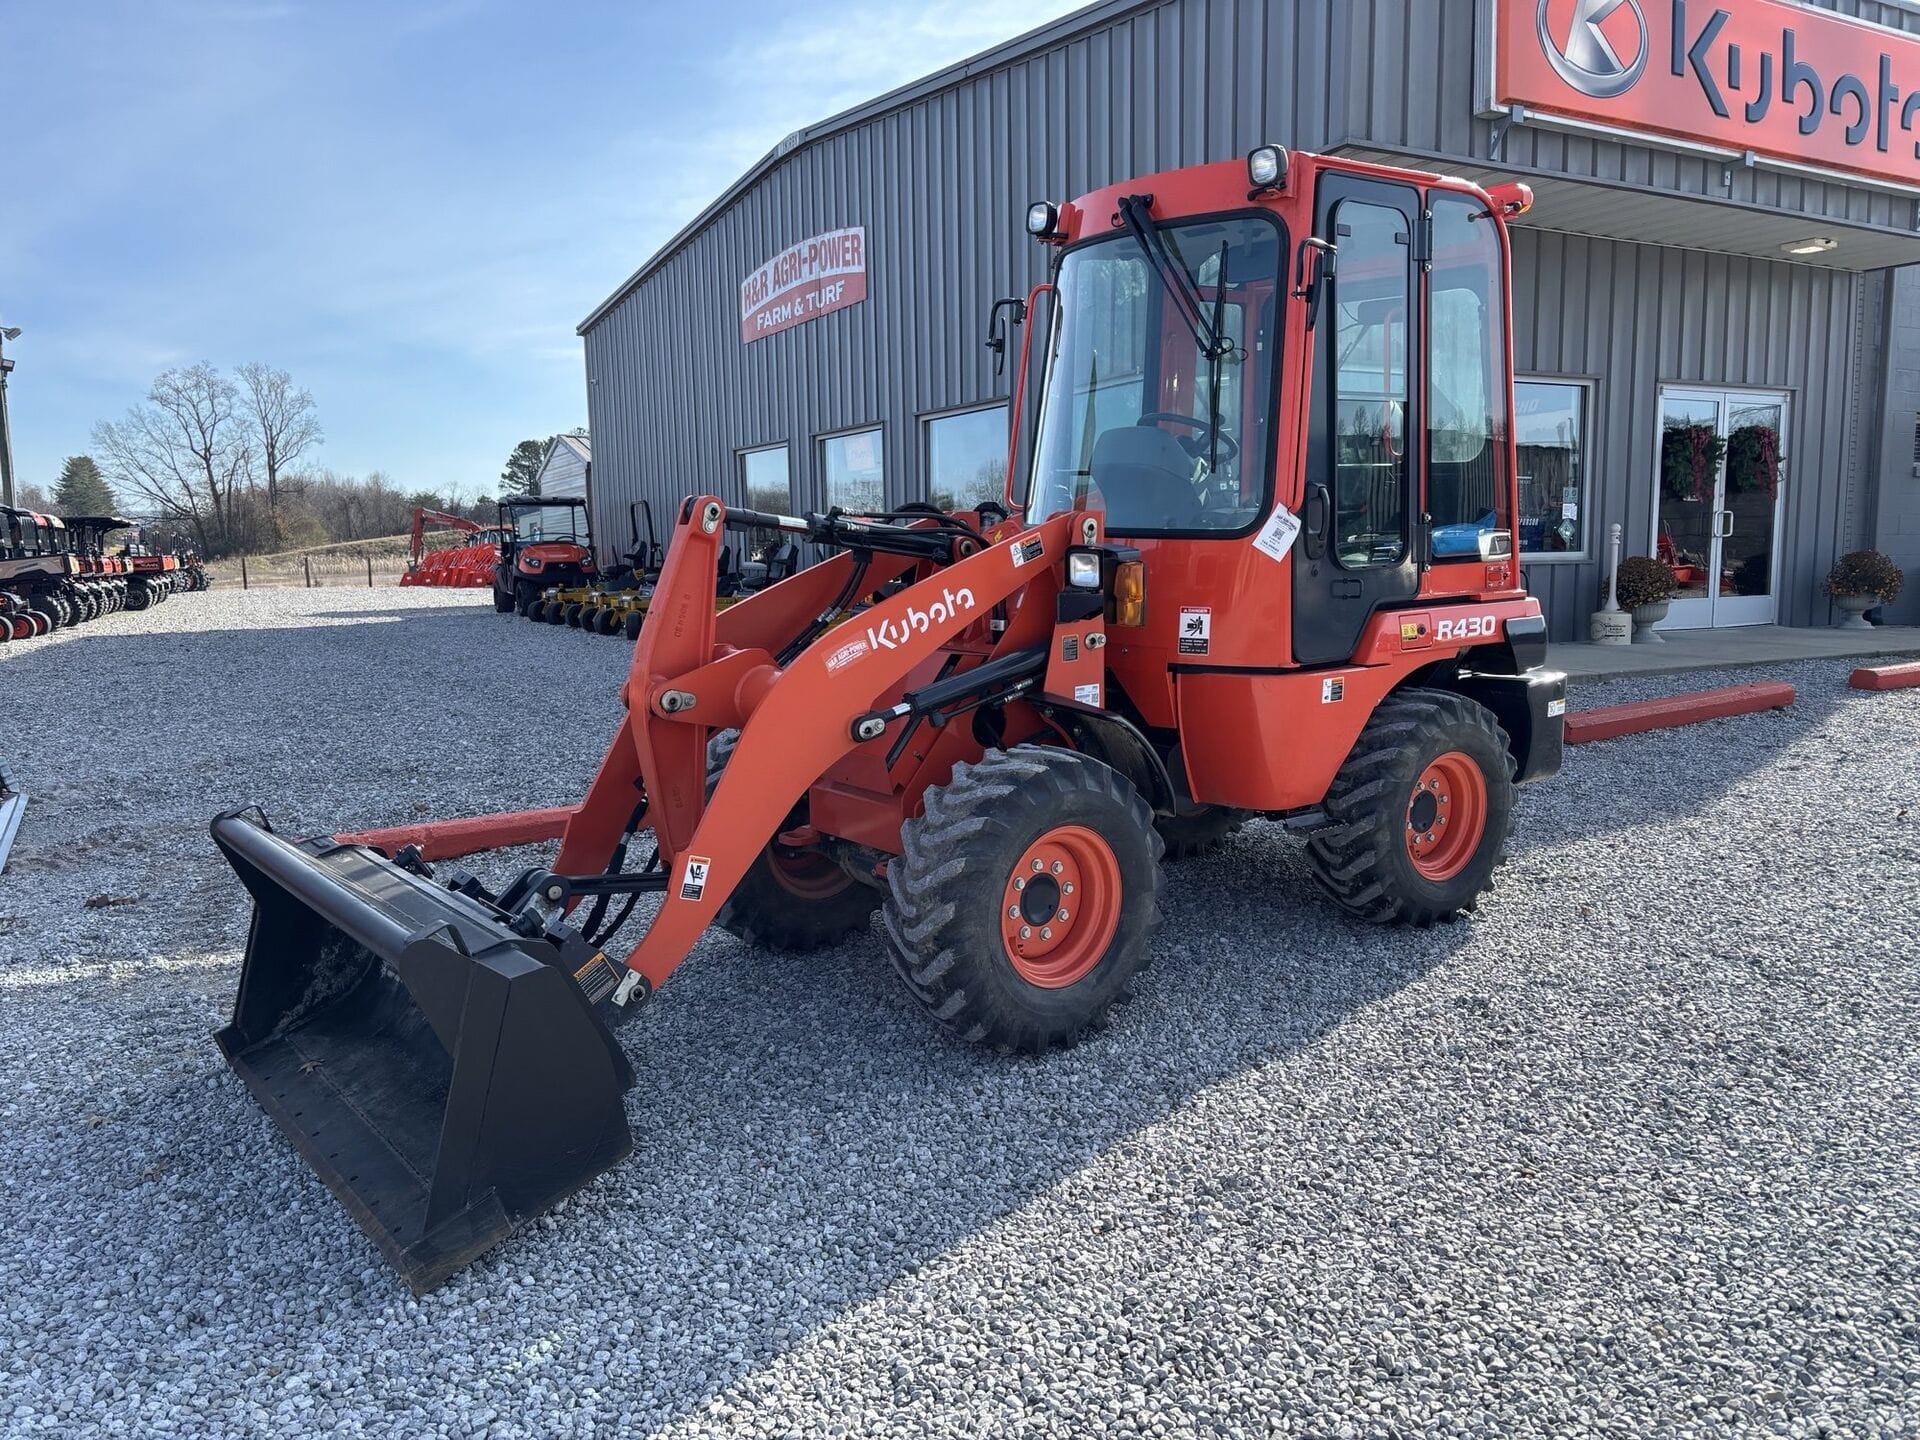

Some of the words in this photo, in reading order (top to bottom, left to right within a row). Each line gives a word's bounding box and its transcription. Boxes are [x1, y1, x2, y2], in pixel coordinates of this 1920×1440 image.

[743, 270, 768, 315] H&R
[773, 234, 862, 292] AGRI-POWER
[757, 302, 791, 331] FARM
[794, 297, 804, 316] &
[806, 280, 845, 311] TURF
[867, 587, 976, 650] Kubota
[1437, 615, 1496, 640] R430
